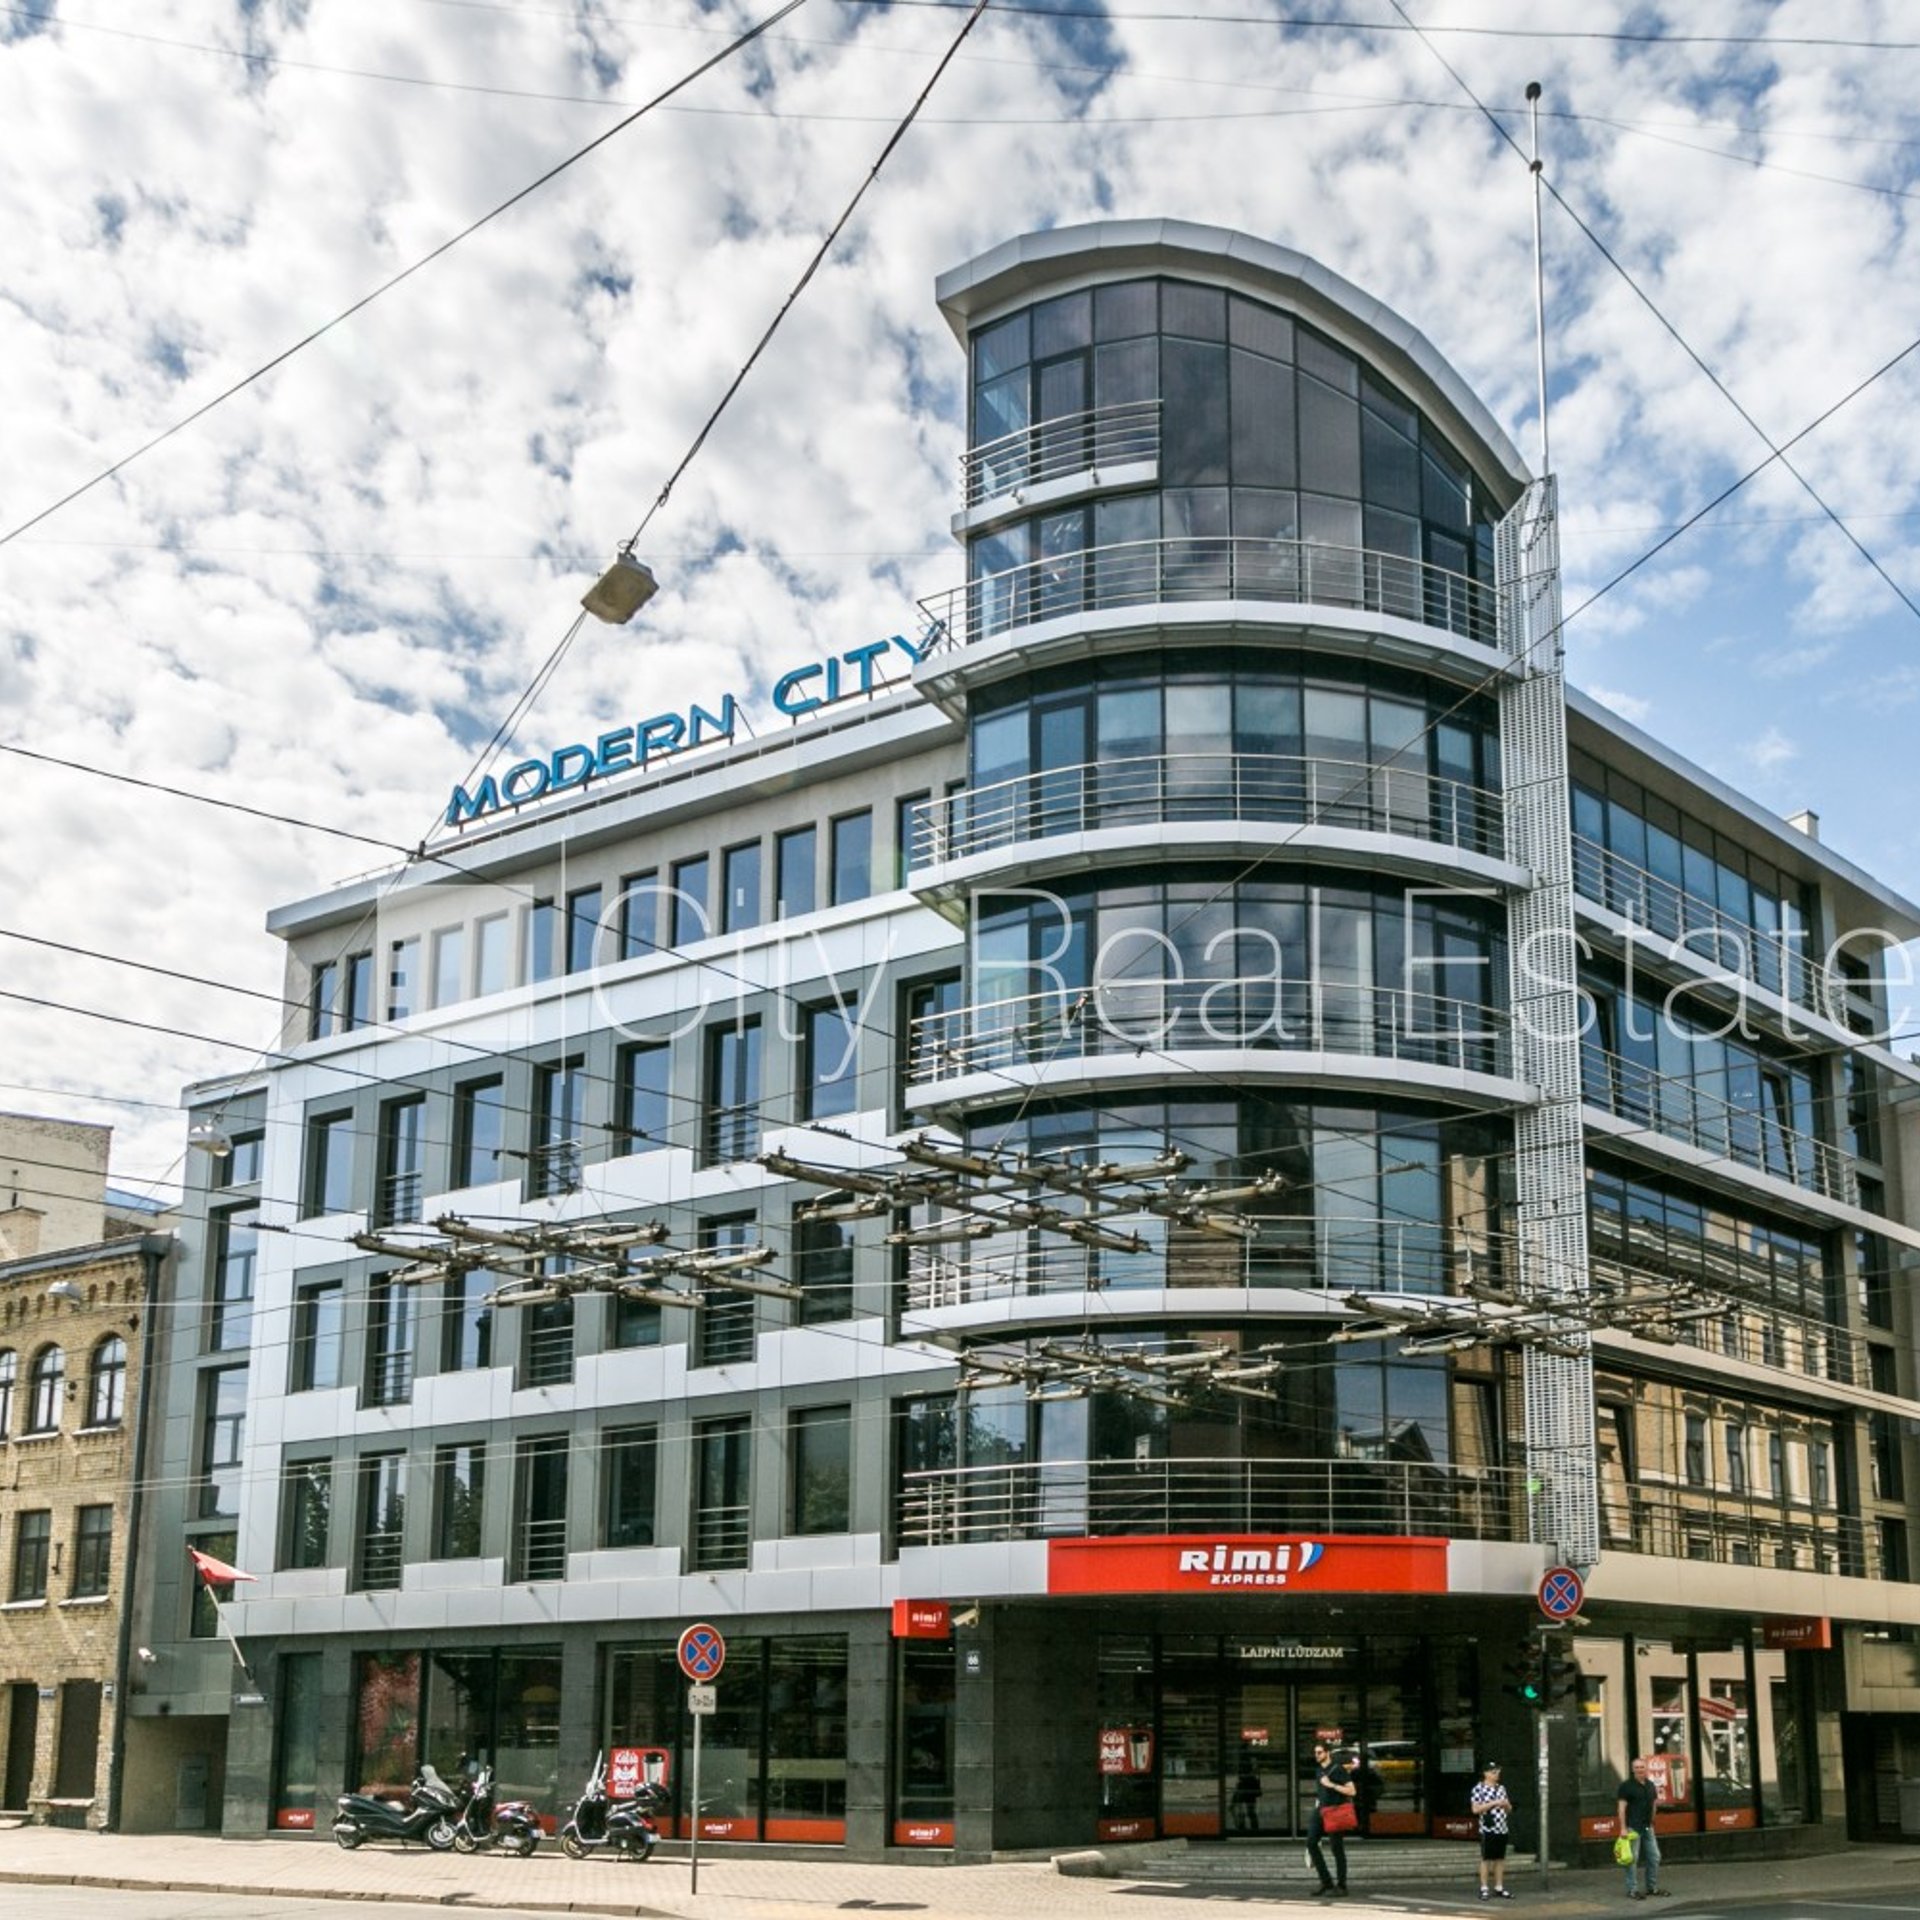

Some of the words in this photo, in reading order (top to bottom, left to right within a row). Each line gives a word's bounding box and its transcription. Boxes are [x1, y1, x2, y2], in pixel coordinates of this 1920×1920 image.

[445, 693, 736, 826] MODERN
[772, 619, 947, 718] CITY
[1210, 1573, 1288, 1585] EXPRESS
[1240, 1646, 1286, 1658] LAIPNI
